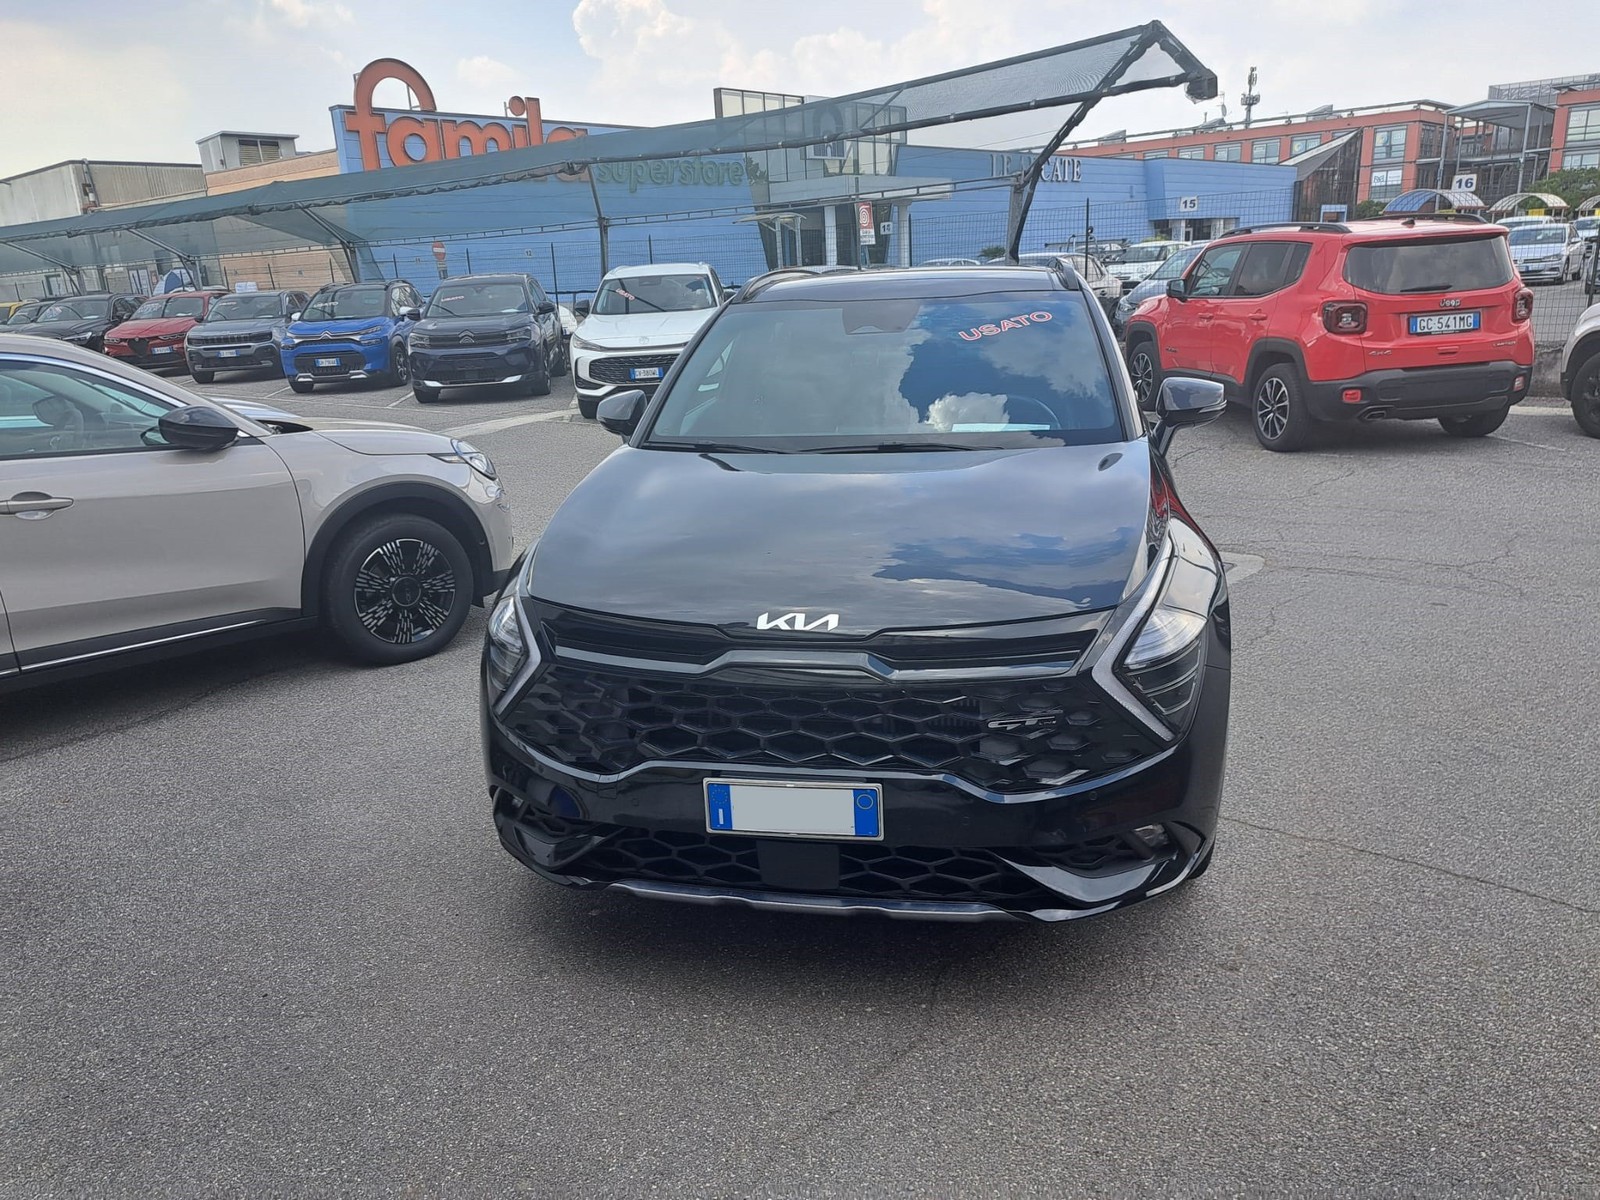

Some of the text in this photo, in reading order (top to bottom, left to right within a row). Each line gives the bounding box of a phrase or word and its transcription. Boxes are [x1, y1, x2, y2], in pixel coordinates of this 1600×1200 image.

[343, 57, 745, 193] famila superstore
[1455, 178, 1474, 188] 16
[1182, 199, 1196, 209] 15
[1439, 299, 1461, 307] Jeep
[959, 311, 1053, 341] USATO
[756, 612, 839, 631] KIA
